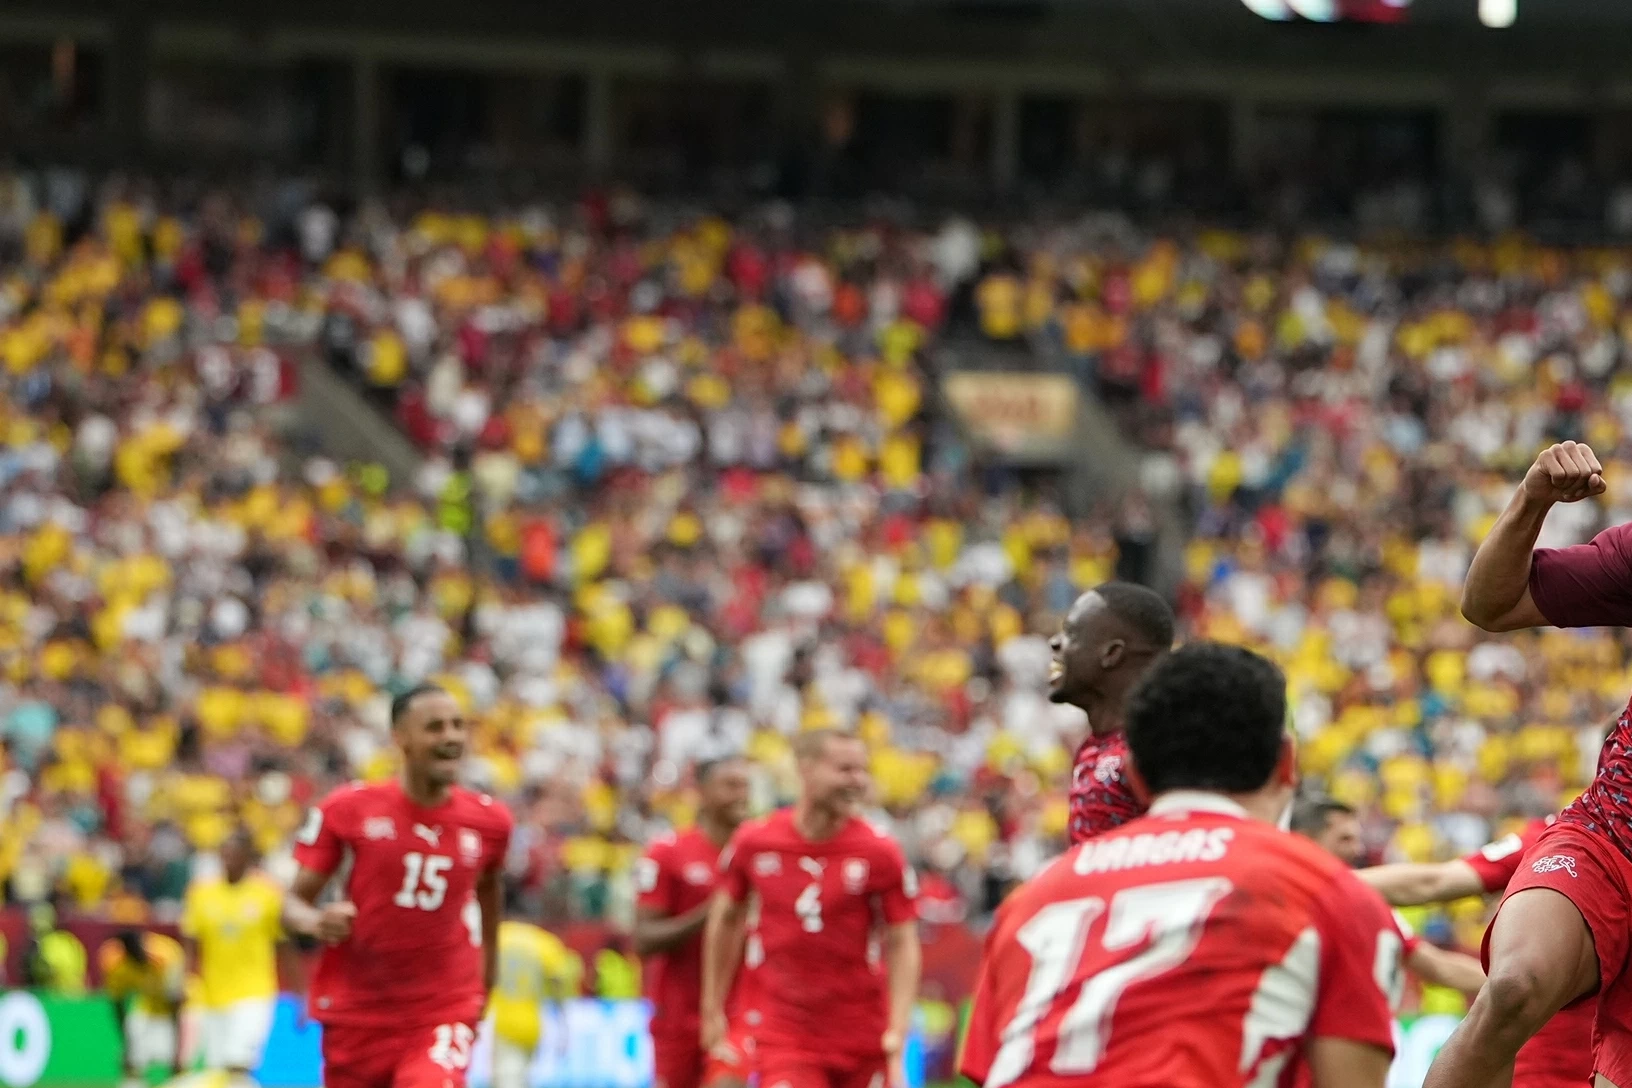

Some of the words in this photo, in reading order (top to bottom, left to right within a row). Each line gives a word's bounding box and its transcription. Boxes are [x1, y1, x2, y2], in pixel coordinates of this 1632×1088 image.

[1072, 826, 1235, 876] VARGAS
[394, 850, 454, 911] 15
[795, 883, 823, 933] 4
